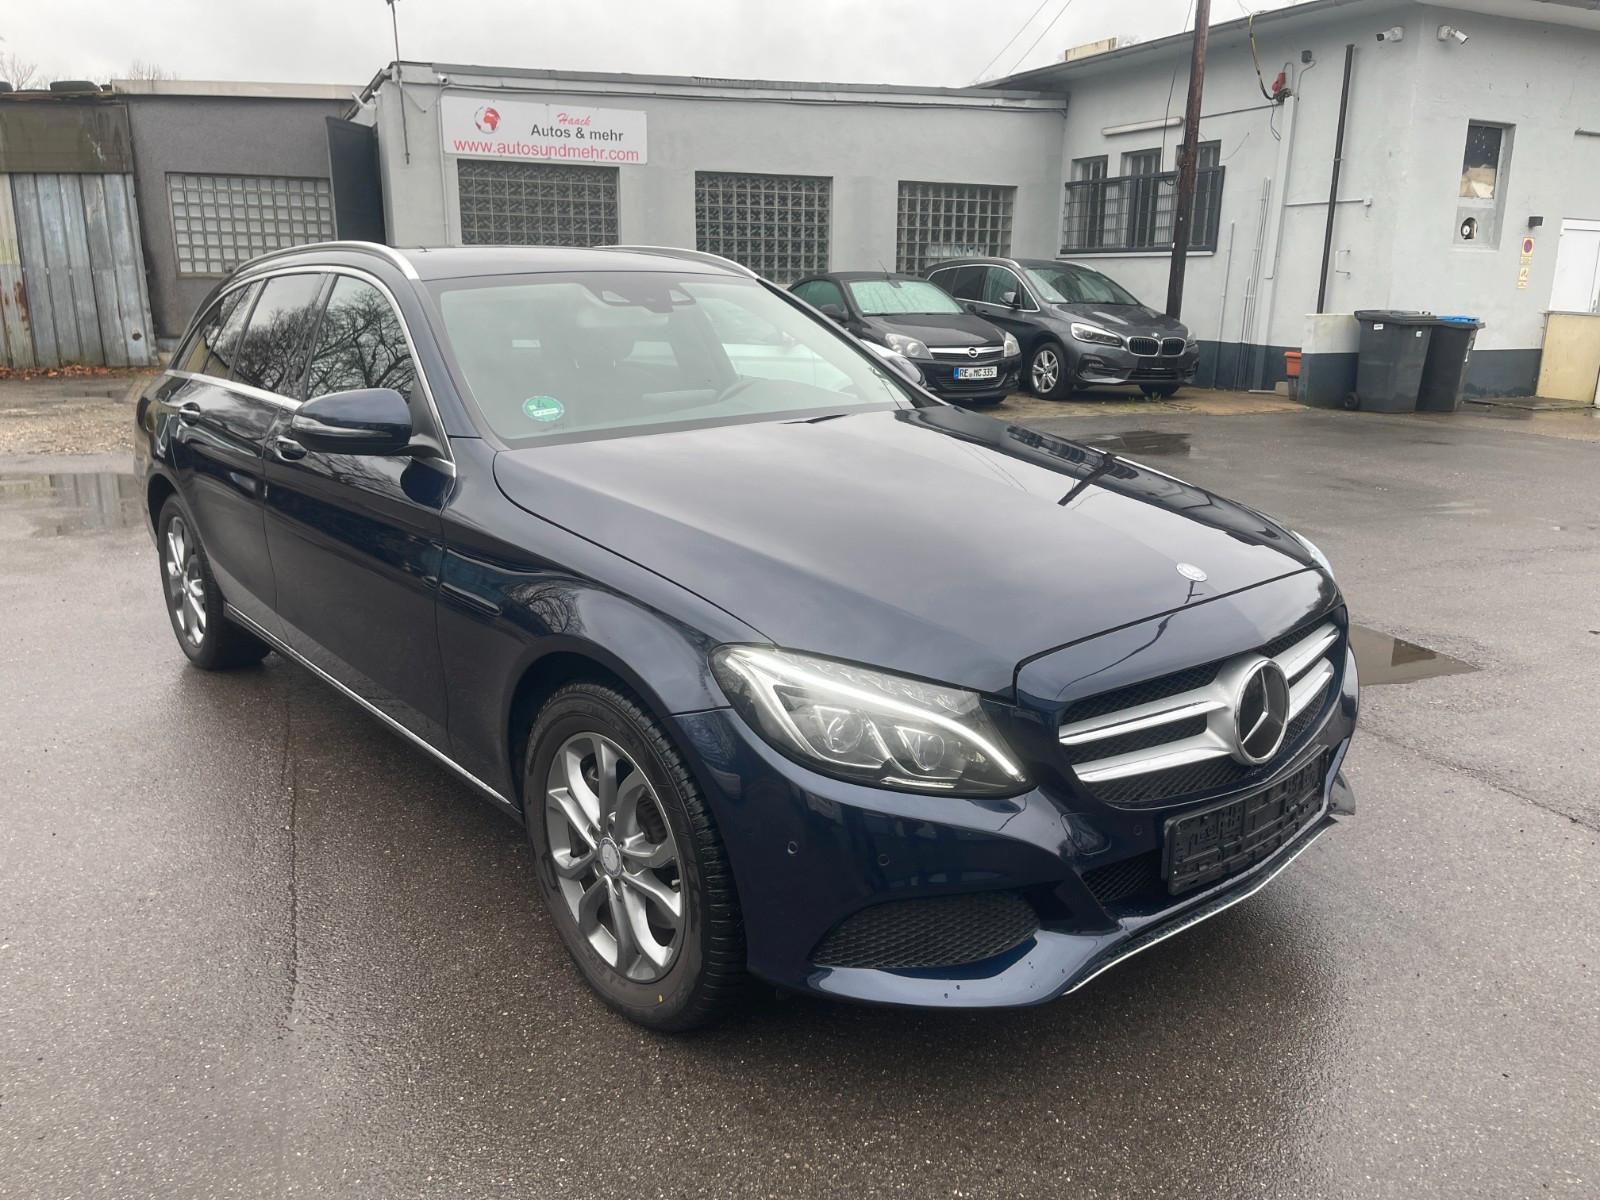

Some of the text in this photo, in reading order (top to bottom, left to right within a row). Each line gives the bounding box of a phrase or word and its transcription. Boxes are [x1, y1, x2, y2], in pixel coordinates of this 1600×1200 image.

[557, 112, 592, 127] Haack
[530, 124, 624, 142] Autos & mehr
[454, 140, 639, 161] www.autosundmehr.com
[960, 369, 968, 377] RE
